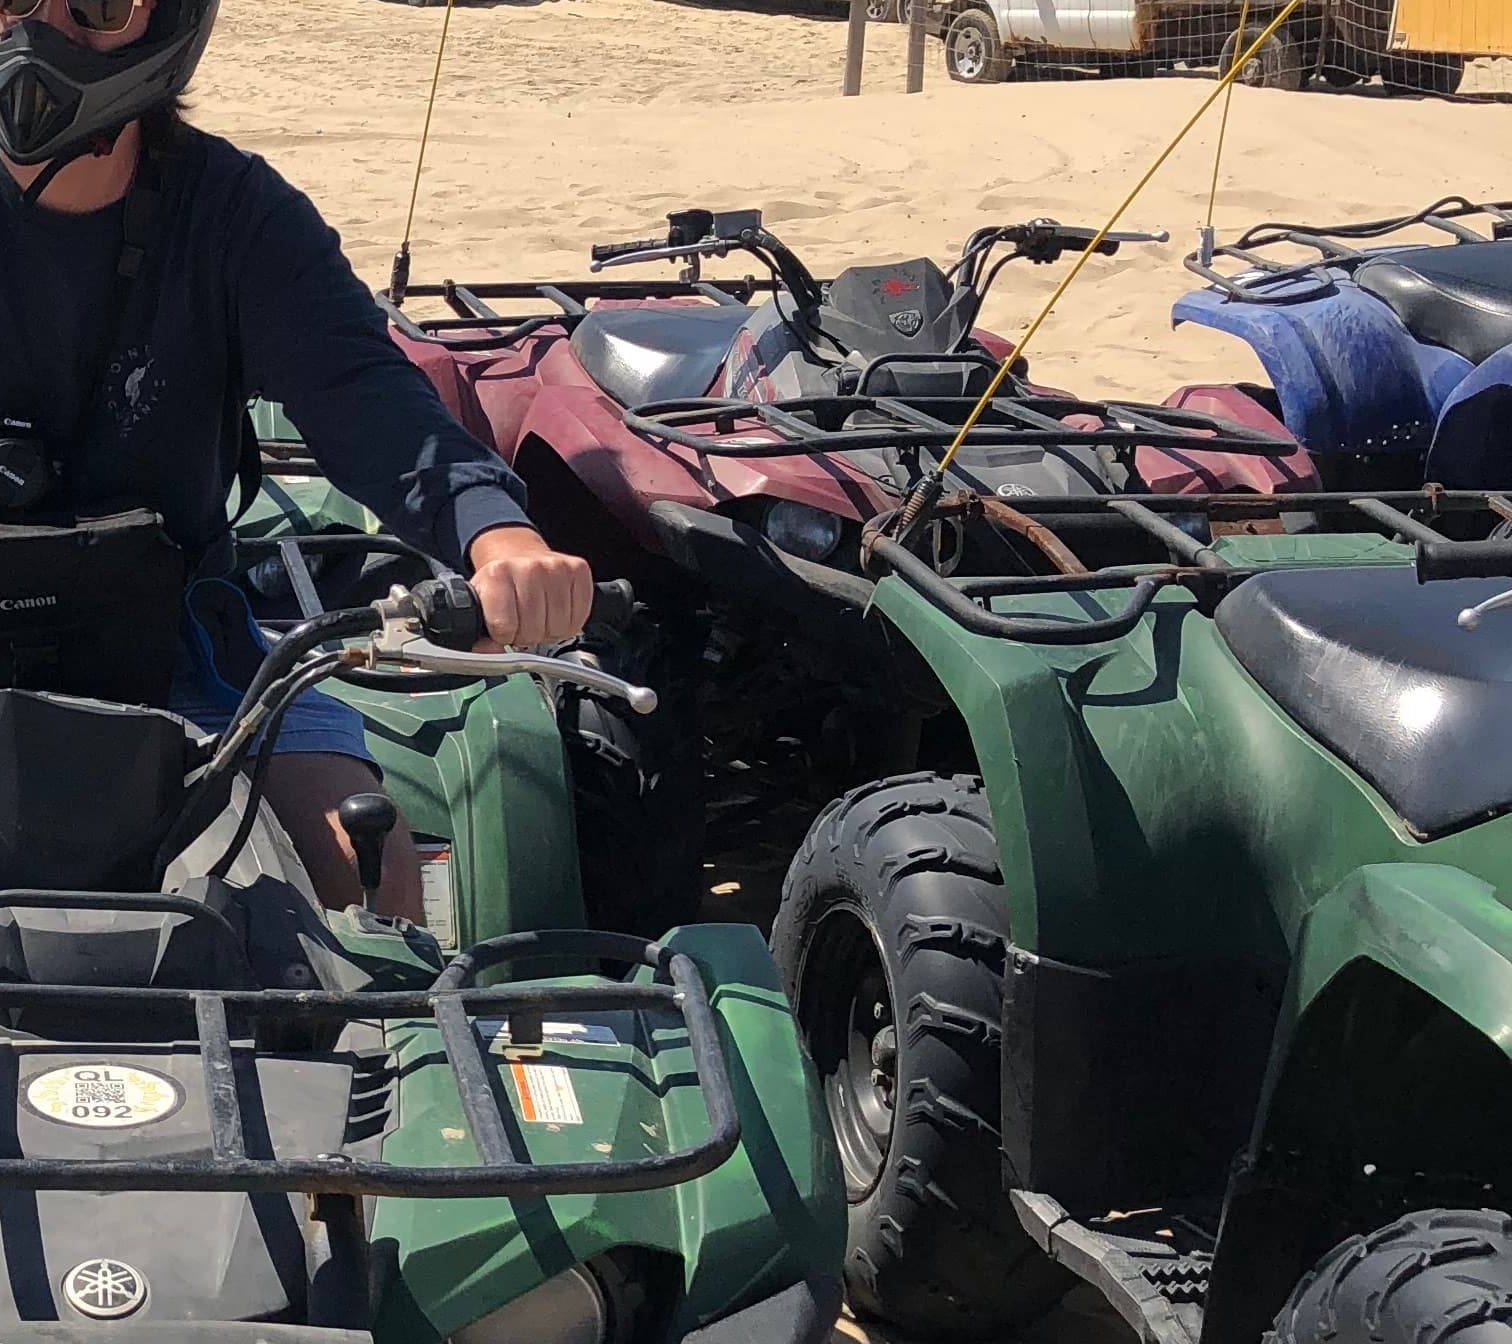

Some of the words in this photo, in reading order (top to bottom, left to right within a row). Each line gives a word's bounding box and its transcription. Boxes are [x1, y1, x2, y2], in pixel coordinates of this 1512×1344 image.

[3, 417, 32, 429] Canon
[0, 594, 57, 611] Canon
[74, 1070, 125, 1083] QL
[71, 1104, 133, 1119] 092
